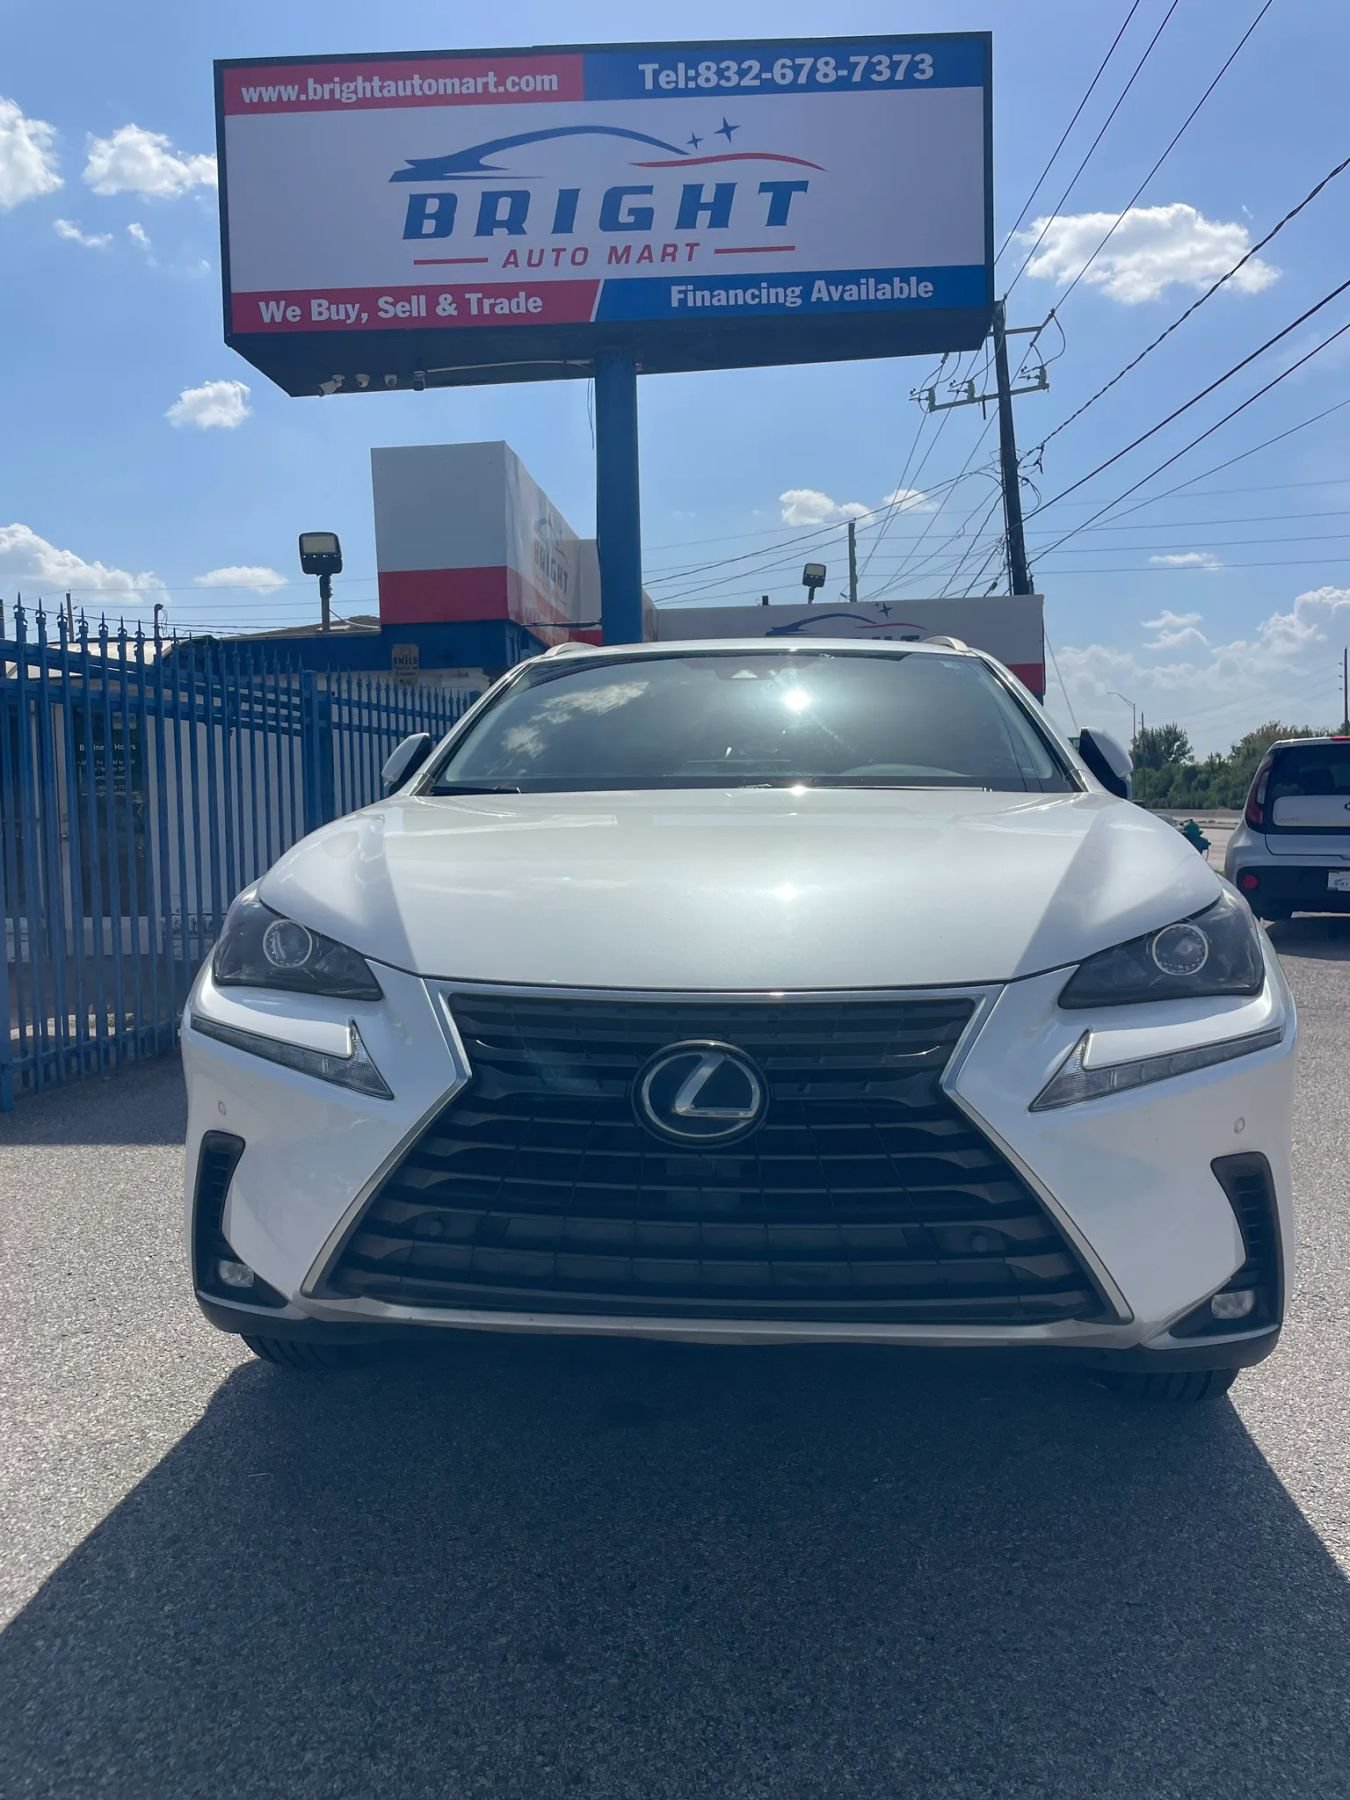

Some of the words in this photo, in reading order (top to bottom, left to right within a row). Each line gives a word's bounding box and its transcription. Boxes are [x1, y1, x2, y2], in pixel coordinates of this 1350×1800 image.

[241, 70, 559, 103] www.brightautomart.com
[638, 53, 934, 91] Tel:832-678-7373
[402, 180, 809, 240] BRIGHT
[502, 247, 590, 269] AUTO
[607, 242, 700, 265] MART
[259, 300, 302, 324] We
[310, 298, 369, 325] Buy,
[377, 294, 427, 319] Sell
[435, 293, 458, 317] &
[465, 291, 543, 317] Trade
[670, 281, 803, 309] Financing
[810, 275, 934, 304] Available
